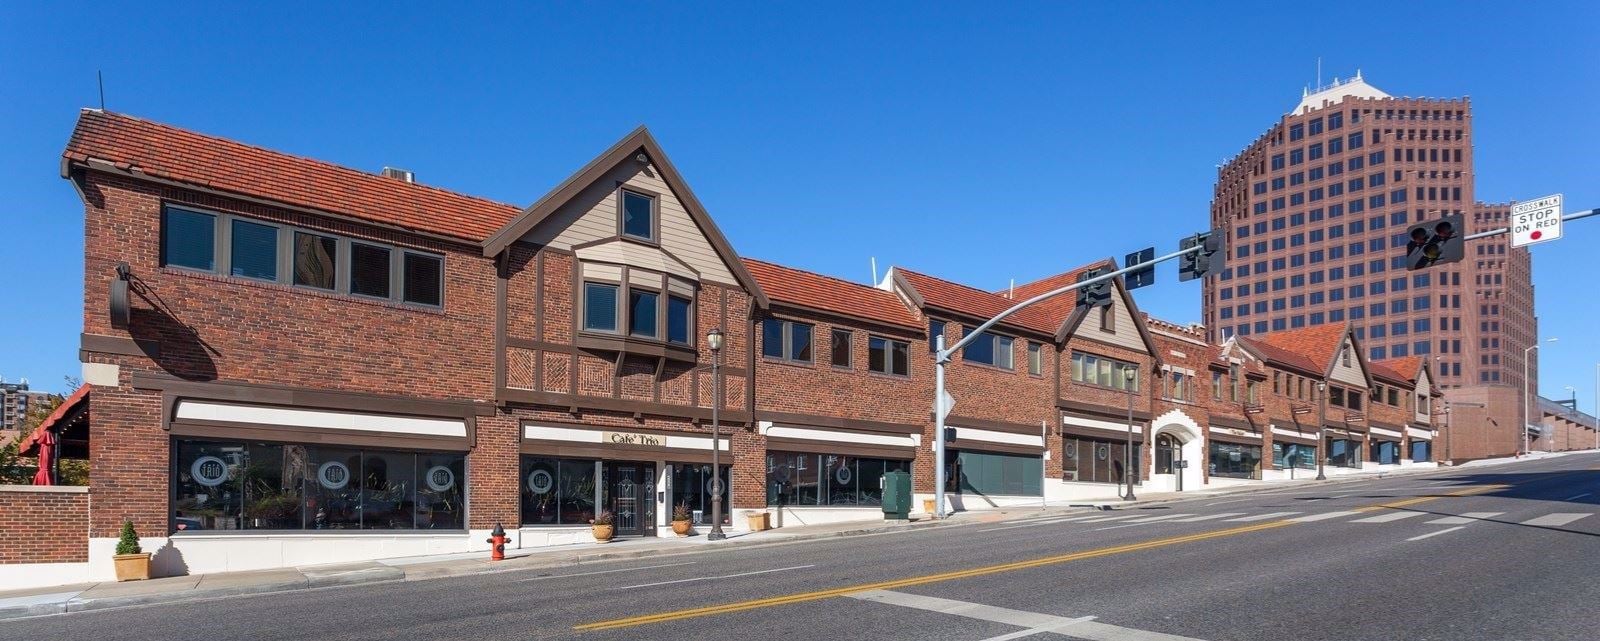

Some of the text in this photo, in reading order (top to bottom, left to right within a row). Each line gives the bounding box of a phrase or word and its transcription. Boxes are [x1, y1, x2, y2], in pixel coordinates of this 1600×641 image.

[1514, 198, 1558, 213] CROSSWALK
[1519, 209, 1553, 224] STOP
[1515, 218, 1558, 234] ON RED
[638, 435, 659, 446] Trio
[201, 465, 221, 477] TRIO
